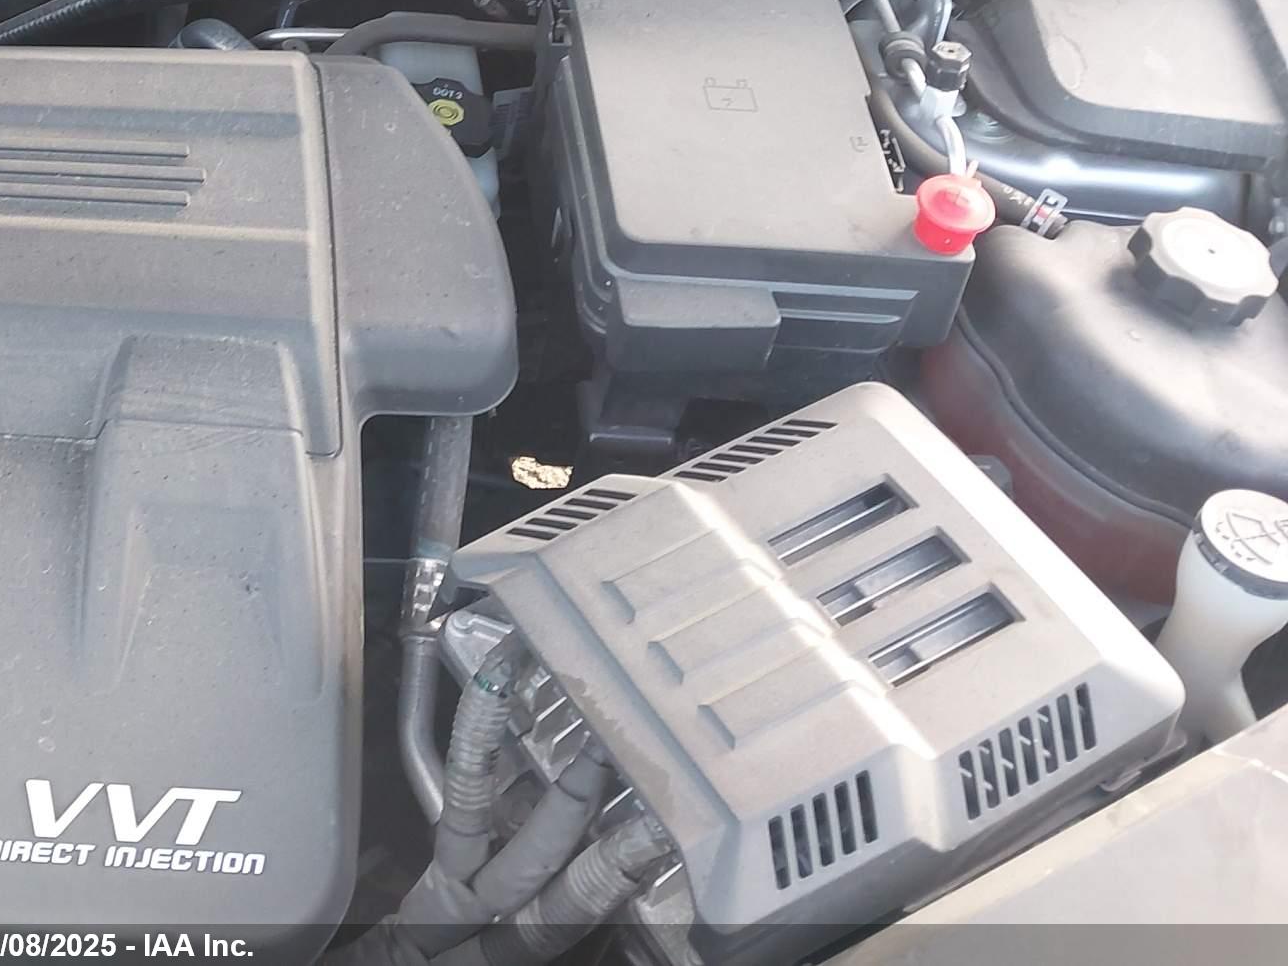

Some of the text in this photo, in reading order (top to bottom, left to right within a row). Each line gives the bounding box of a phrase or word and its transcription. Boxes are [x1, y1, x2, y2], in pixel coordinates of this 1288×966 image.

[433, 86, 455, 99] DOT
[25, 779, 243, 846] VVT
[104, 845, 266, 875] INJECTION
